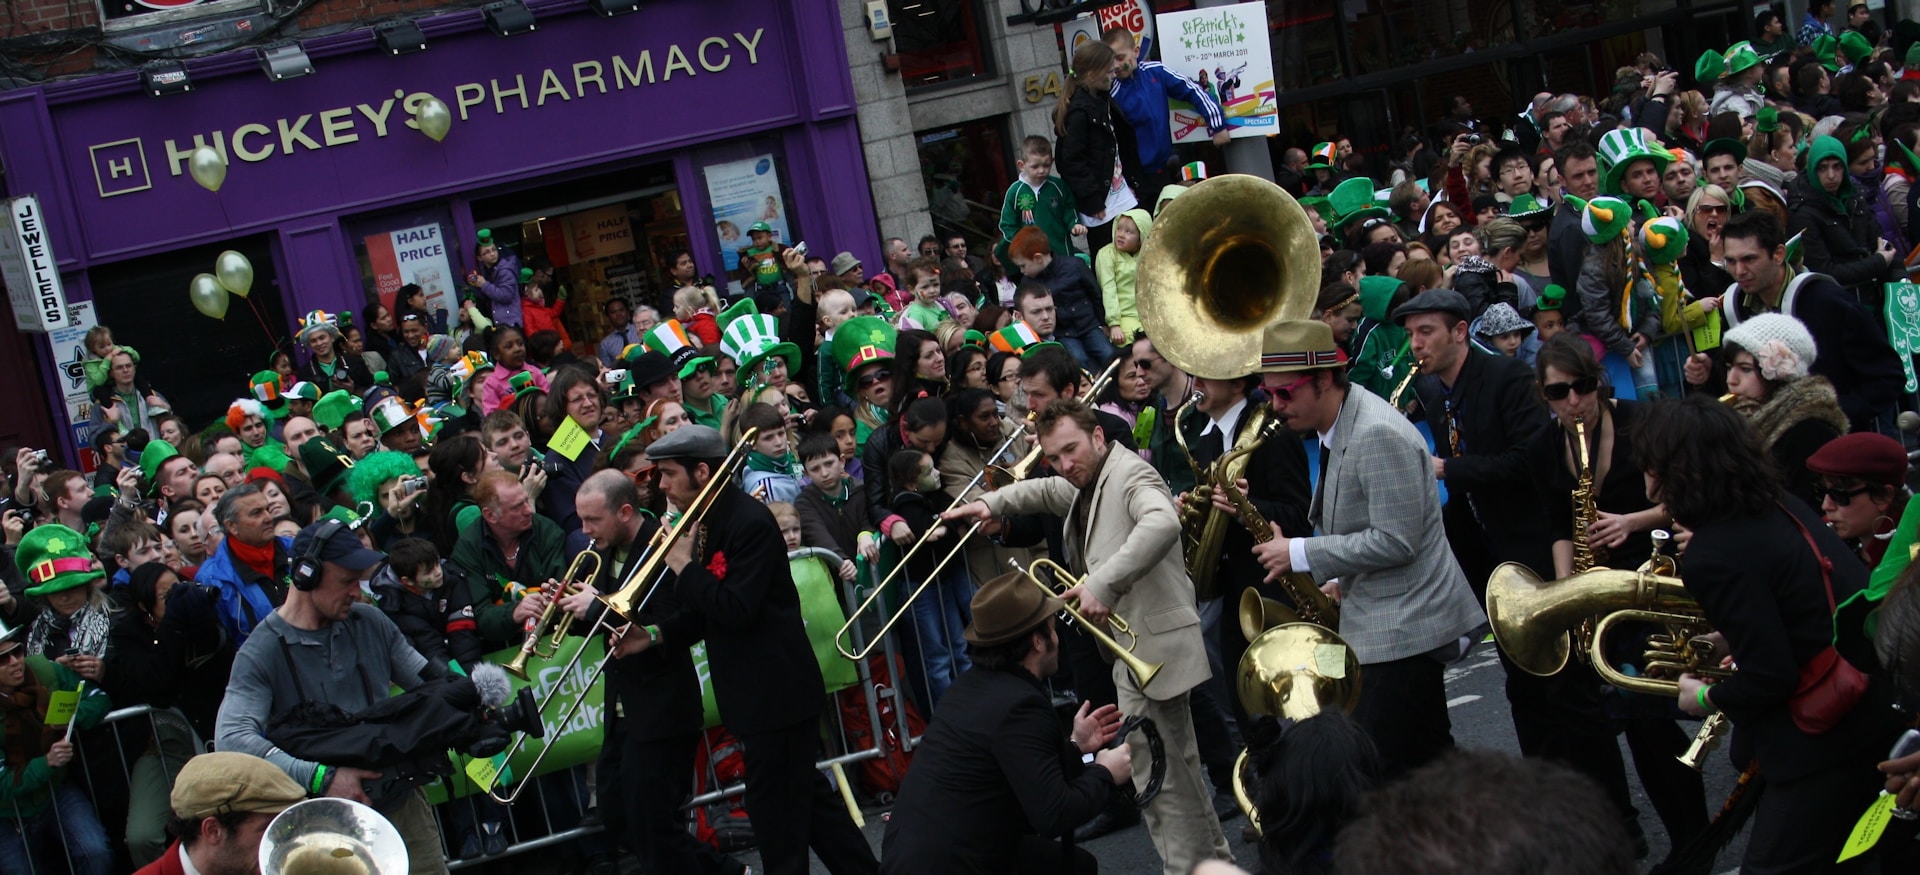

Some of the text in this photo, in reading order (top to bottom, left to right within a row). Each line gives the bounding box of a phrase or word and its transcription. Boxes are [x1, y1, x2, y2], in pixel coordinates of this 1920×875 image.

[1213, 50, 1235, 59] MARCH
[1236, 48, 1248, 57] 2011
[455, 28, 765, 120] PHARMACY
[1025, 71, 1062, 103] 54
[1254, 105, 1273, 115] FAMILY
[1175, 114, 1196, 125] COMEDY
[1244, 117, 1273, 125] SPECTACLE
[1177, 128, 1189, 139] FILM
[597, 216, 626, 230] HALF
[397, 227, 437, 245] HALF
[599, 228, 631, 243] PRICE
[400, 244, 443, 262] PRICE
[19, 205, 62, 323] JEWELLERS
[378, 273, 394, 281] Feel
[379, 279, 400, 288] Good
[380, 285, 401, 294] Value
